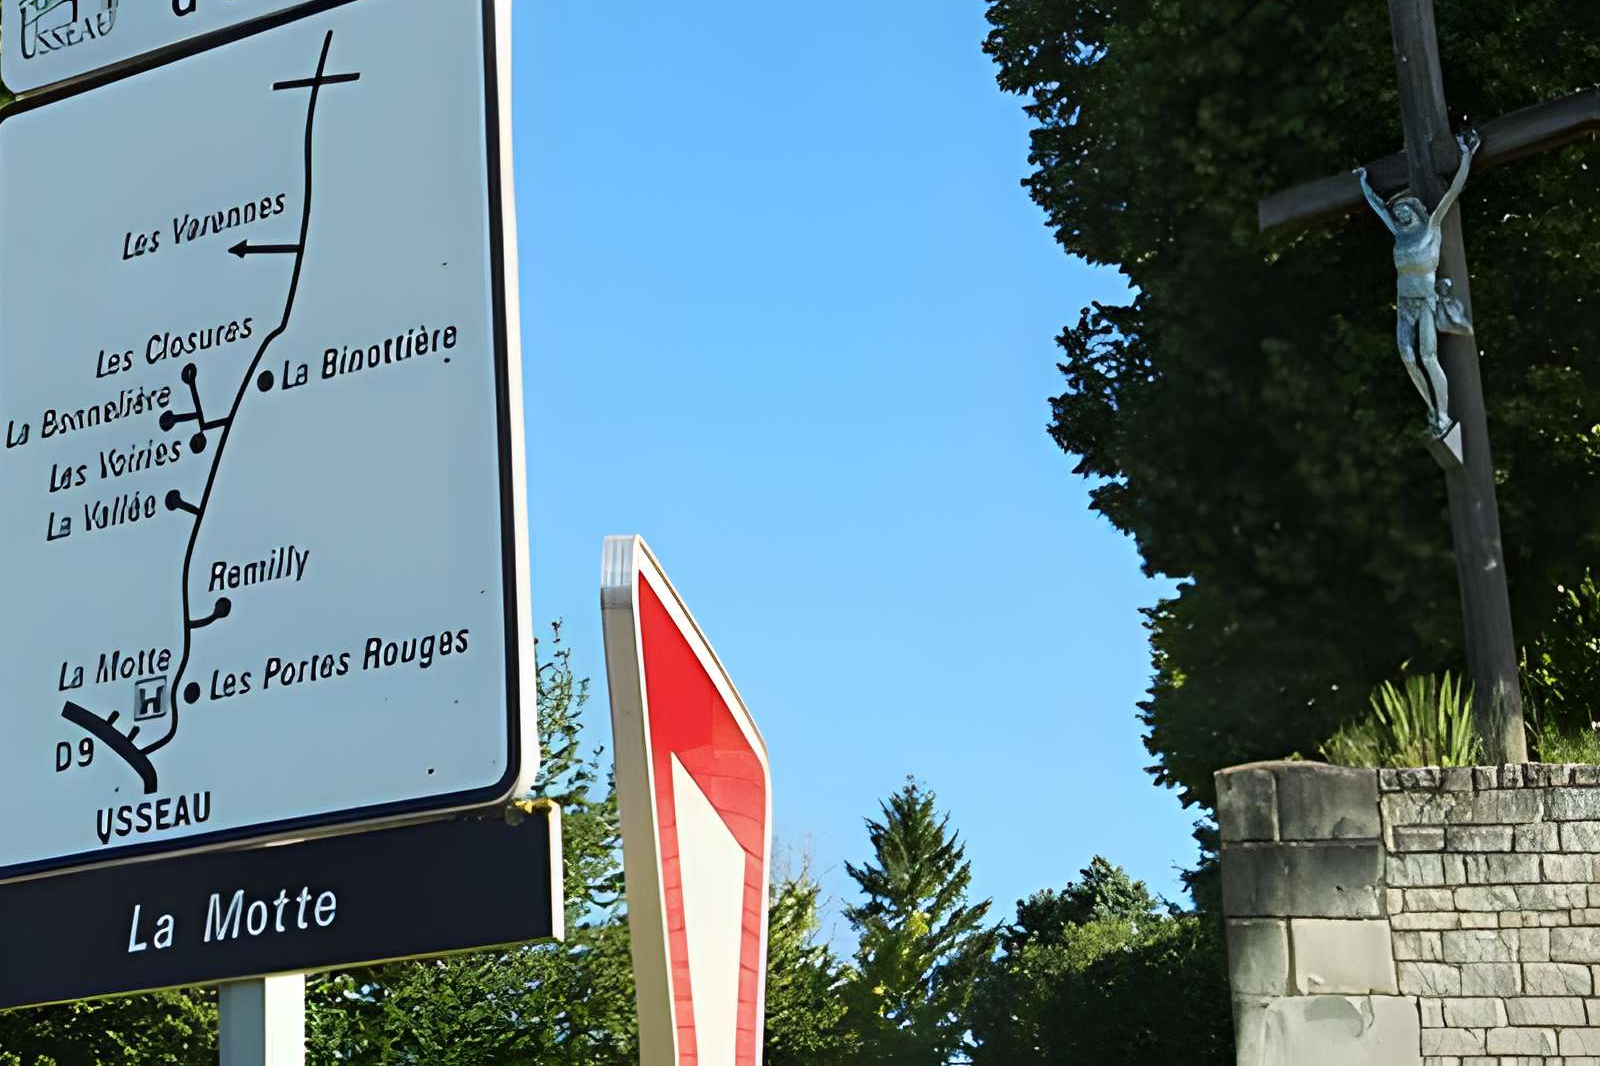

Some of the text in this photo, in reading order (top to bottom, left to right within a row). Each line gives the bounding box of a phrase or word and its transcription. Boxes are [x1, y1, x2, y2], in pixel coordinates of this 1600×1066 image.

[122, 193, 286, 261] Les Varennes
[95, 317, 253, 379] Les Closures
[281, 325, 457, 391] La Binottière
[5, 420, 31, 449] La
[49, 439, 182, 493] Les Voiries
[46, 490, 156, 542] La Vallée
[208, 545, 310, 593] Remilly
[58, 648, 172, 692] La Motte
[210, 628, 469, 701] Les Portes Rouges
[96, 790, 211, 845] USSEAU
[128, 886, 337, 953] La Motte
